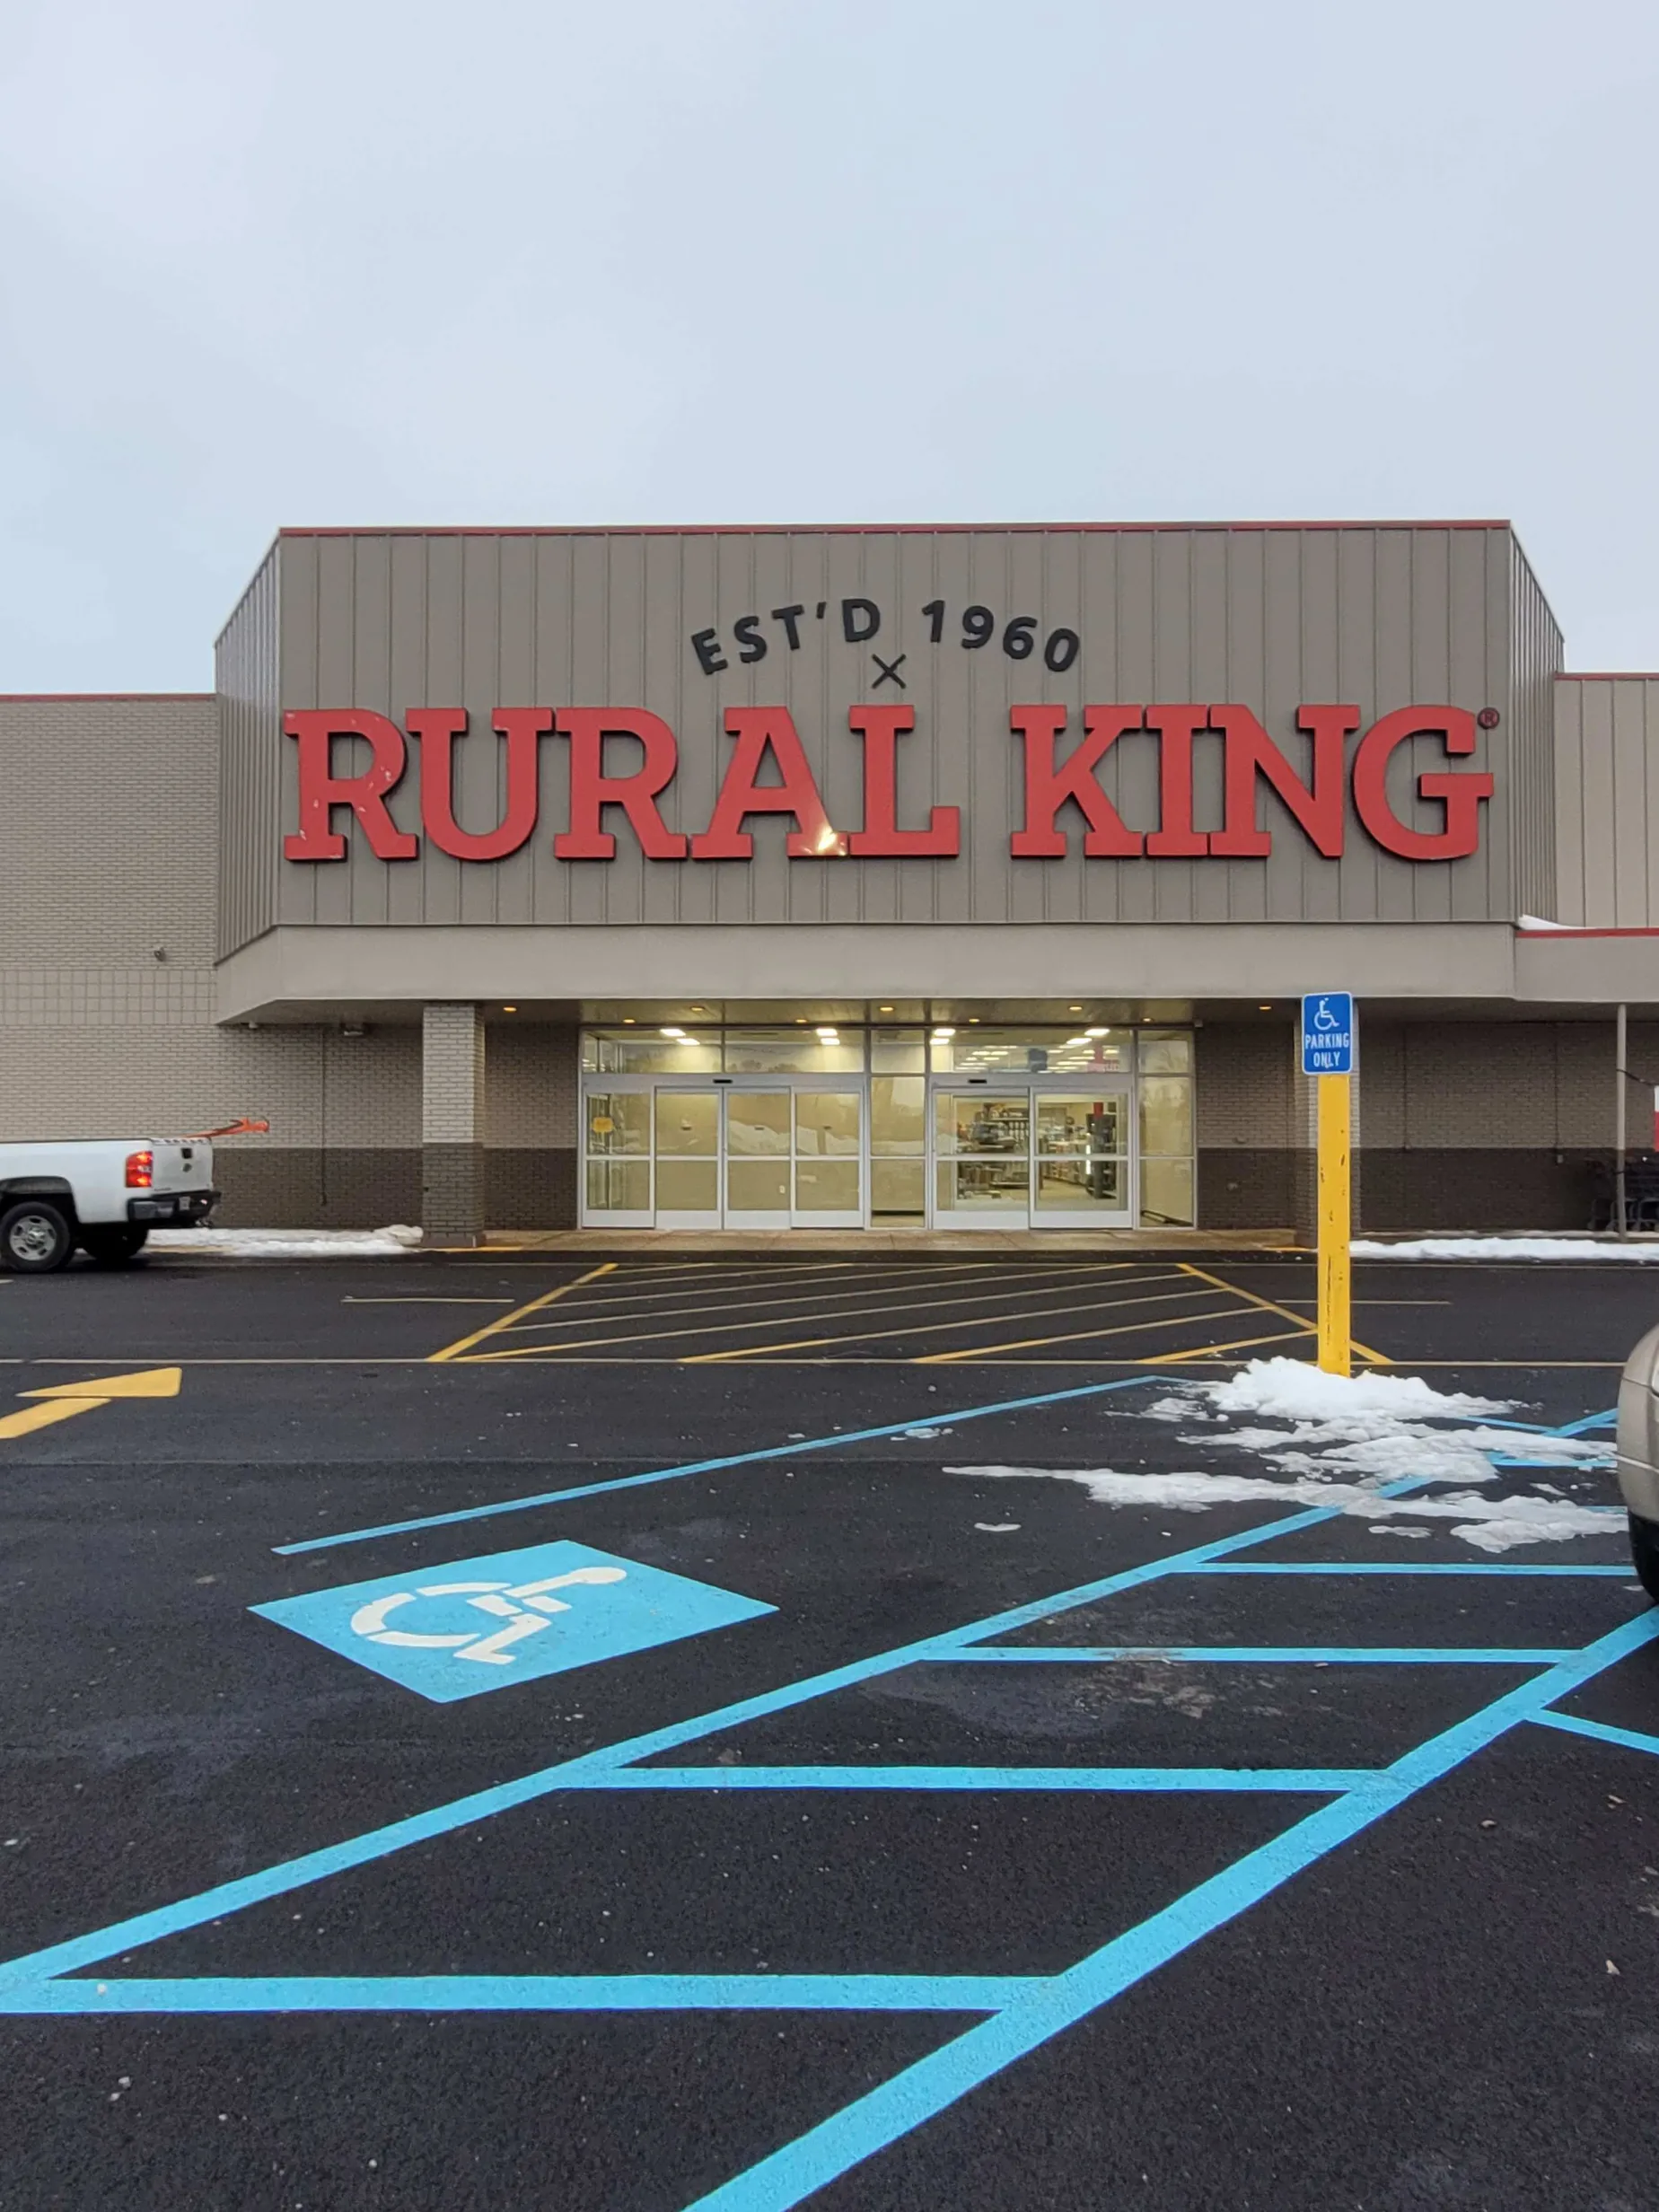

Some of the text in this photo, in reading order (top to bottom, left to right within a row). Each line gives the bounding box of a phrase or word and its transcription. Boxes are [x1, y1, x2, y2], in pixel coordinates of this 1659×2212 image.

[690, 598, 1080, 675] EST'D 1960
[283, 704, 960, 861] RURAL
[1010, 704, 1494, 861] KING
[1304, 1032, 1350, 1049] PARKING
[1312, 1051, 1341, 1068] ONLY
